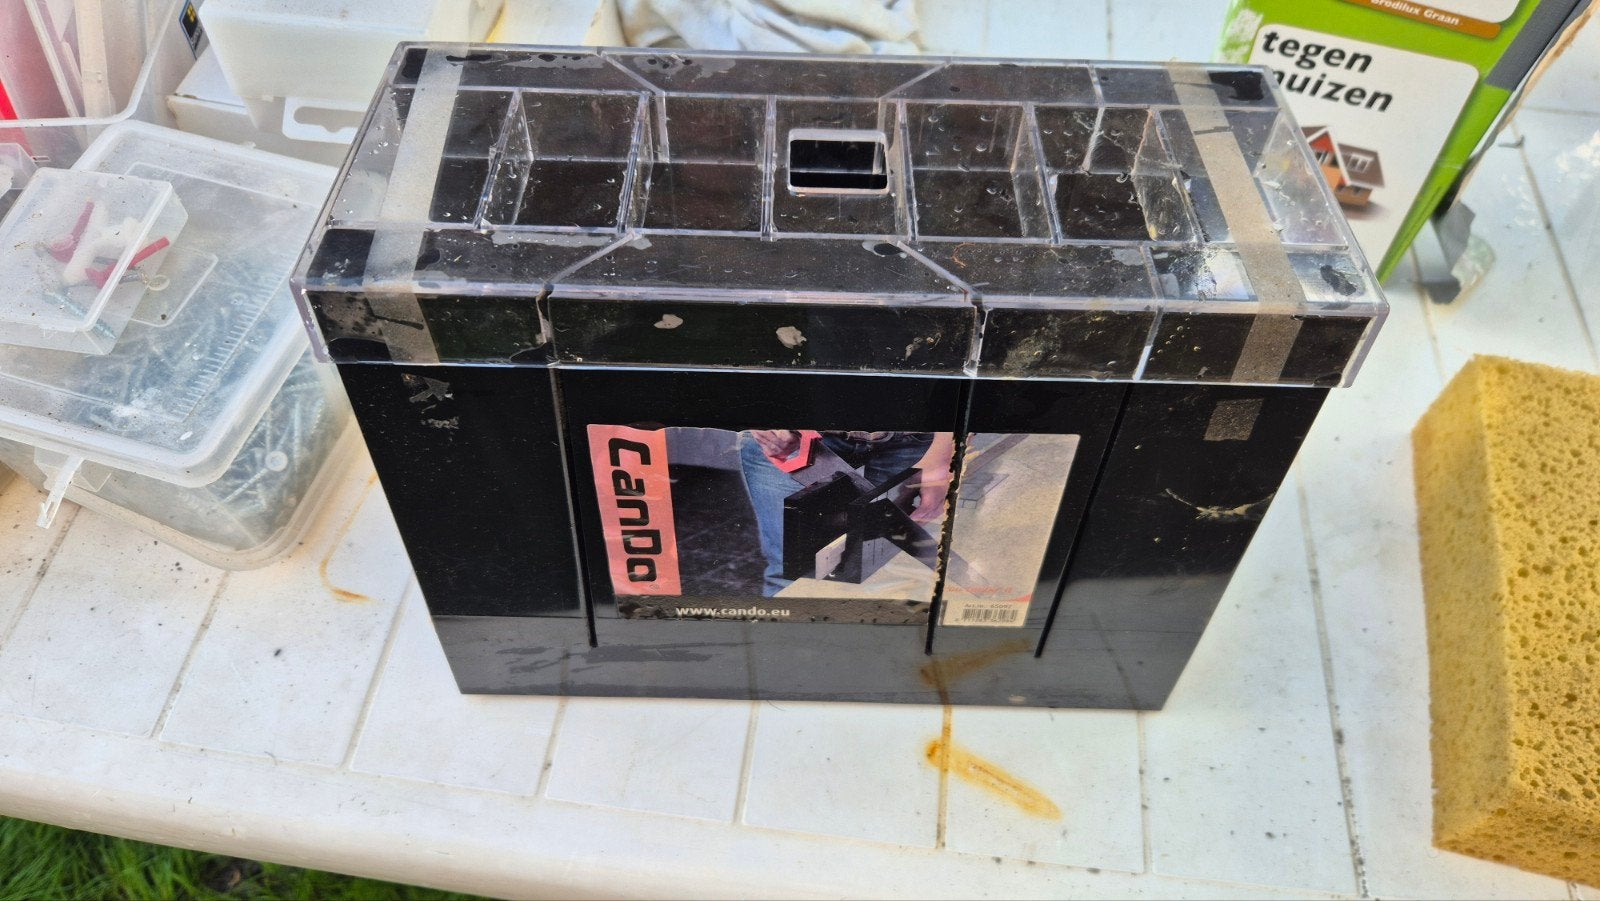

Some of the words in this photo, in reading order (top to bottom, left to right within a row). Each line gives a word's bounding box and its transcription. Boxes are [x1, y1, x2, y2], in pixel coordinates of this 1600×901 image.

[1423, 8, 1460, 26] Graan
[1262, 31, 1373, 73] tegen
[608, 437, 662, 582] CanDo
[676, 606, 790, 617] www.cando.eu
